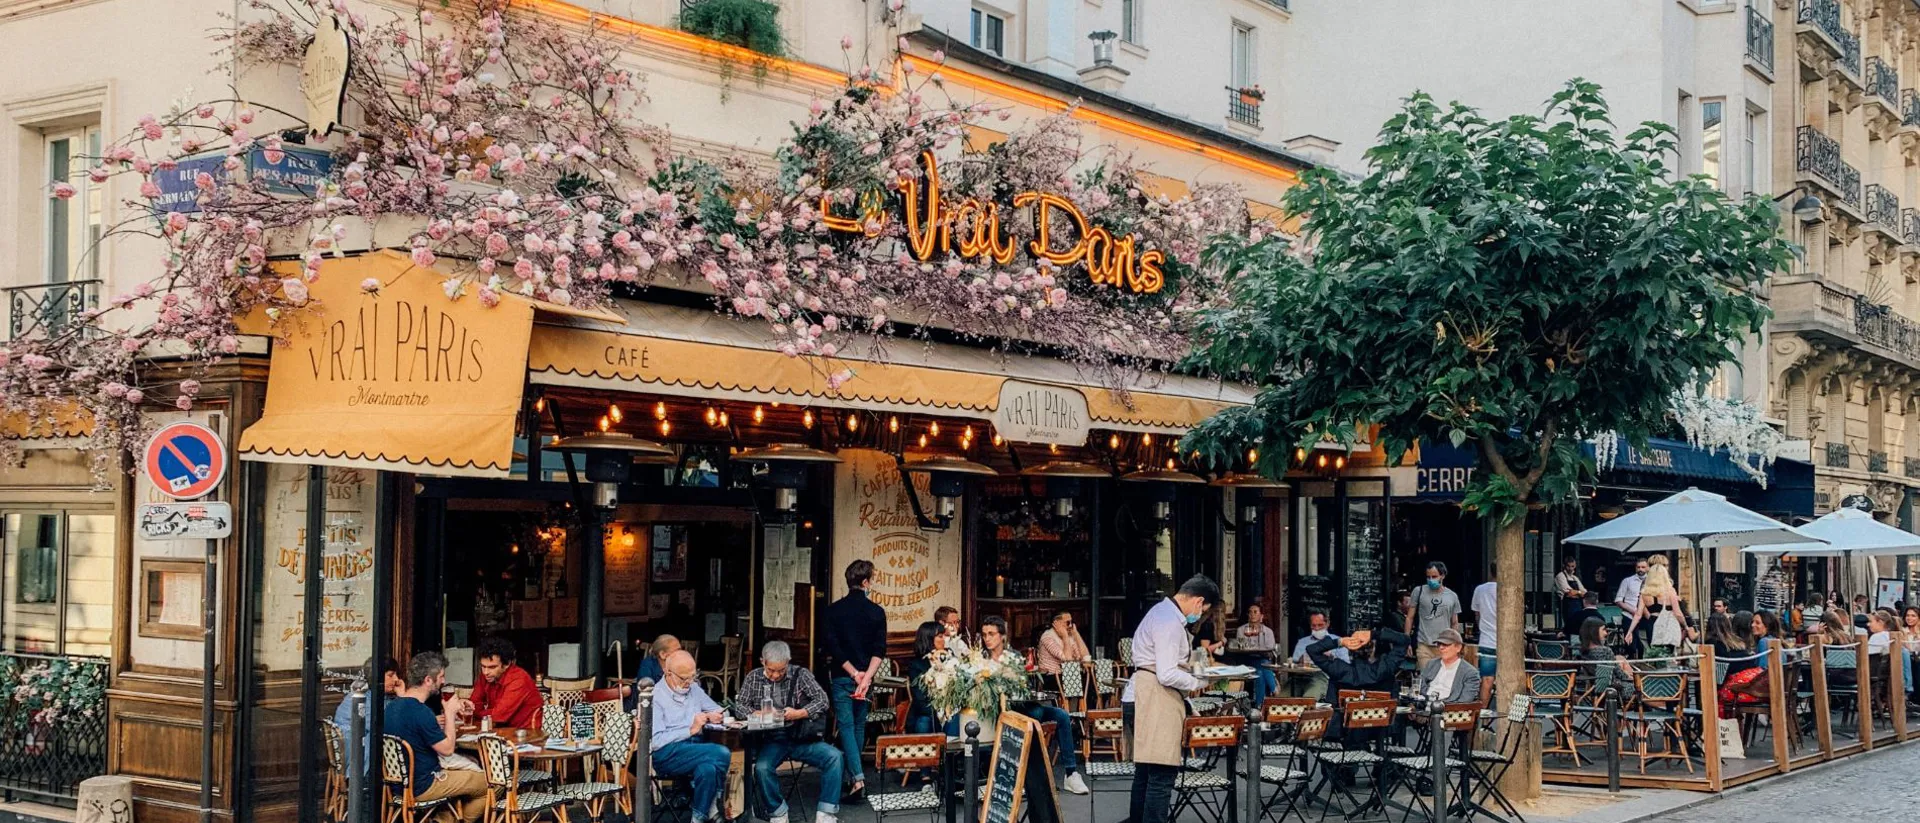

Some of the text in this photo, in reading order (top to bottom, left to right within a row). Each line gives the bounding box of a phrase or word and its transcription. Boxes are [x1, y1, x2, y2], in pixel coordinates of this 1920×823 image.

[158, 189, 196, 206] ERMAIN
[308, 300, 484, 383] VRAI PARIS
[604, 345, 649, 369] CAFÉ
[348, 385, 431, 407] Montmartre
[1005, 389, 1079, 430] VRAI PARIS
[1627, 445, 1637, 464] LE
[872, 540, 930, 559] PRODUITS FRAIS
[894, 566, 928, 588] MAISON
[870, 580, 940, 607] TOUTE HEURE
